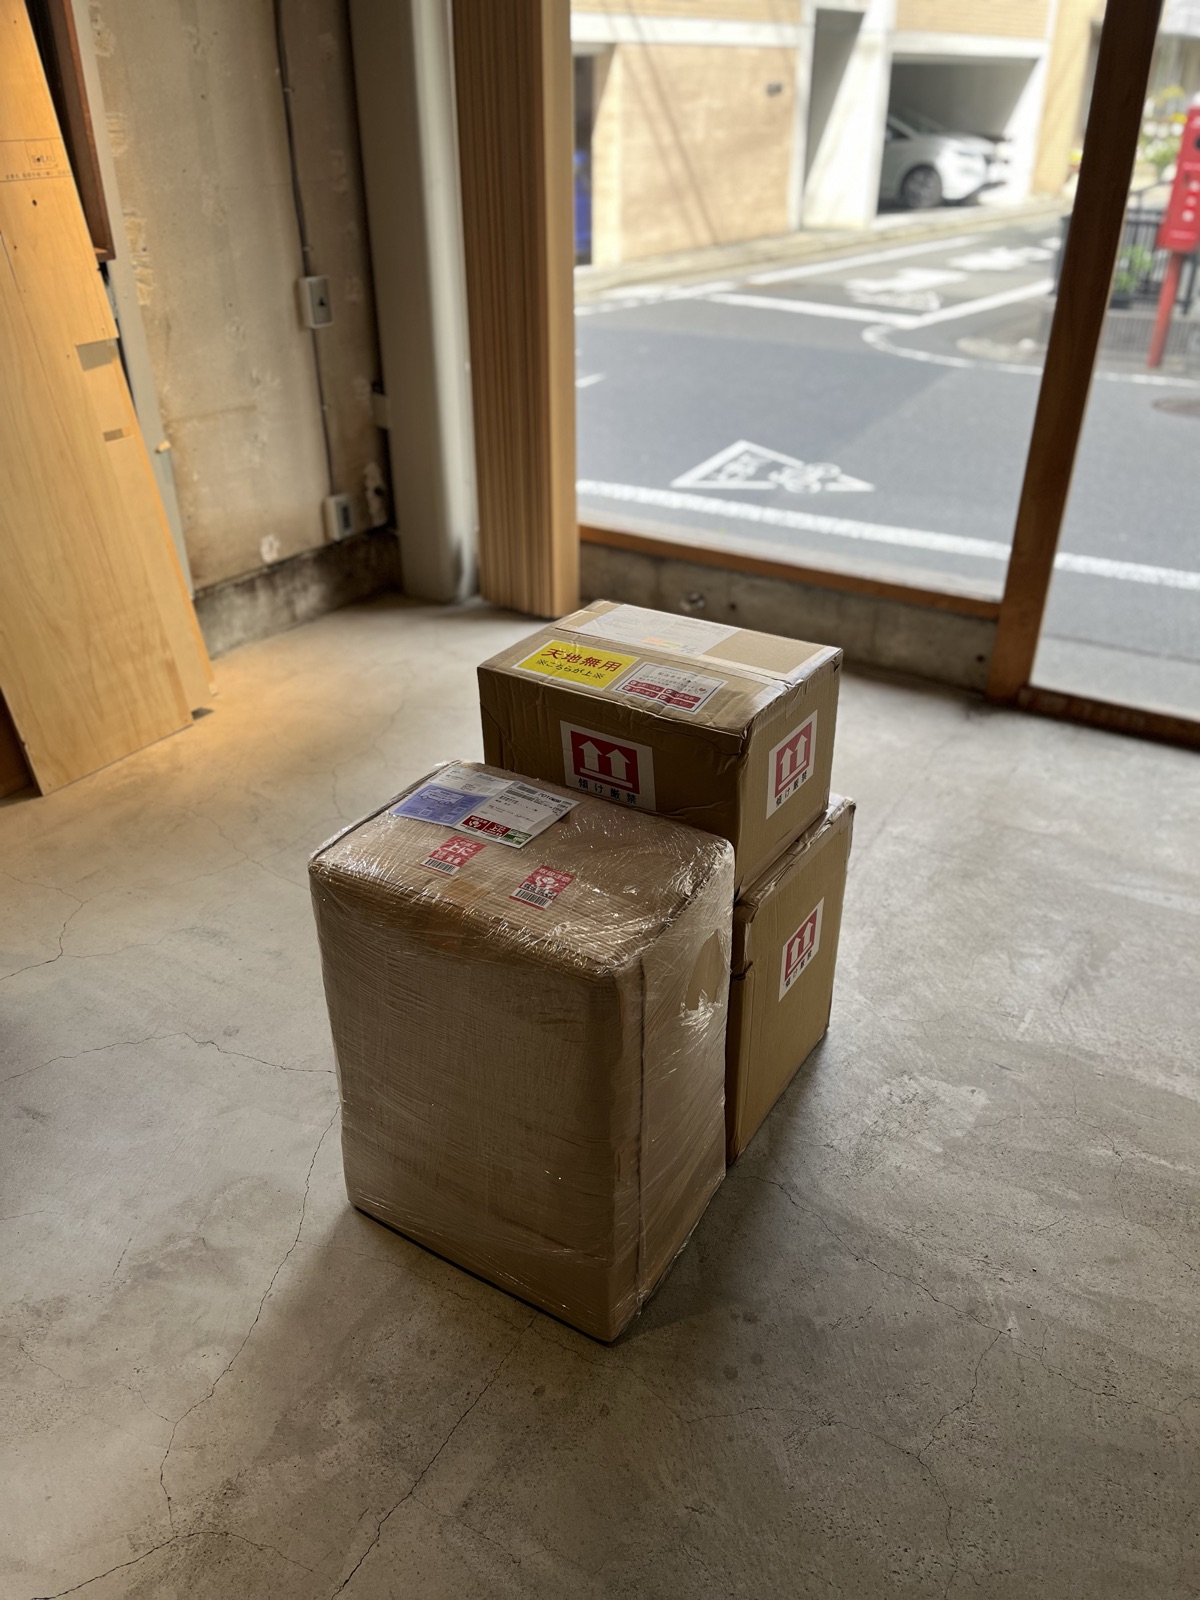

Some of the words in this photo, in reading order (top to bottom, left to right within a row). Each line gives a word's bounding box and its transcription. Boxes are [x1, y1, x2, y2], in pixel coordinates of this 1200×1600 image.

[537, 659, 605, 680] ※こちらが上※
[541, 647, 622, 672] 天地無用
[577, 777, 637, 804] 傾け厳禁
[443, 843, 474, 857] 上に
